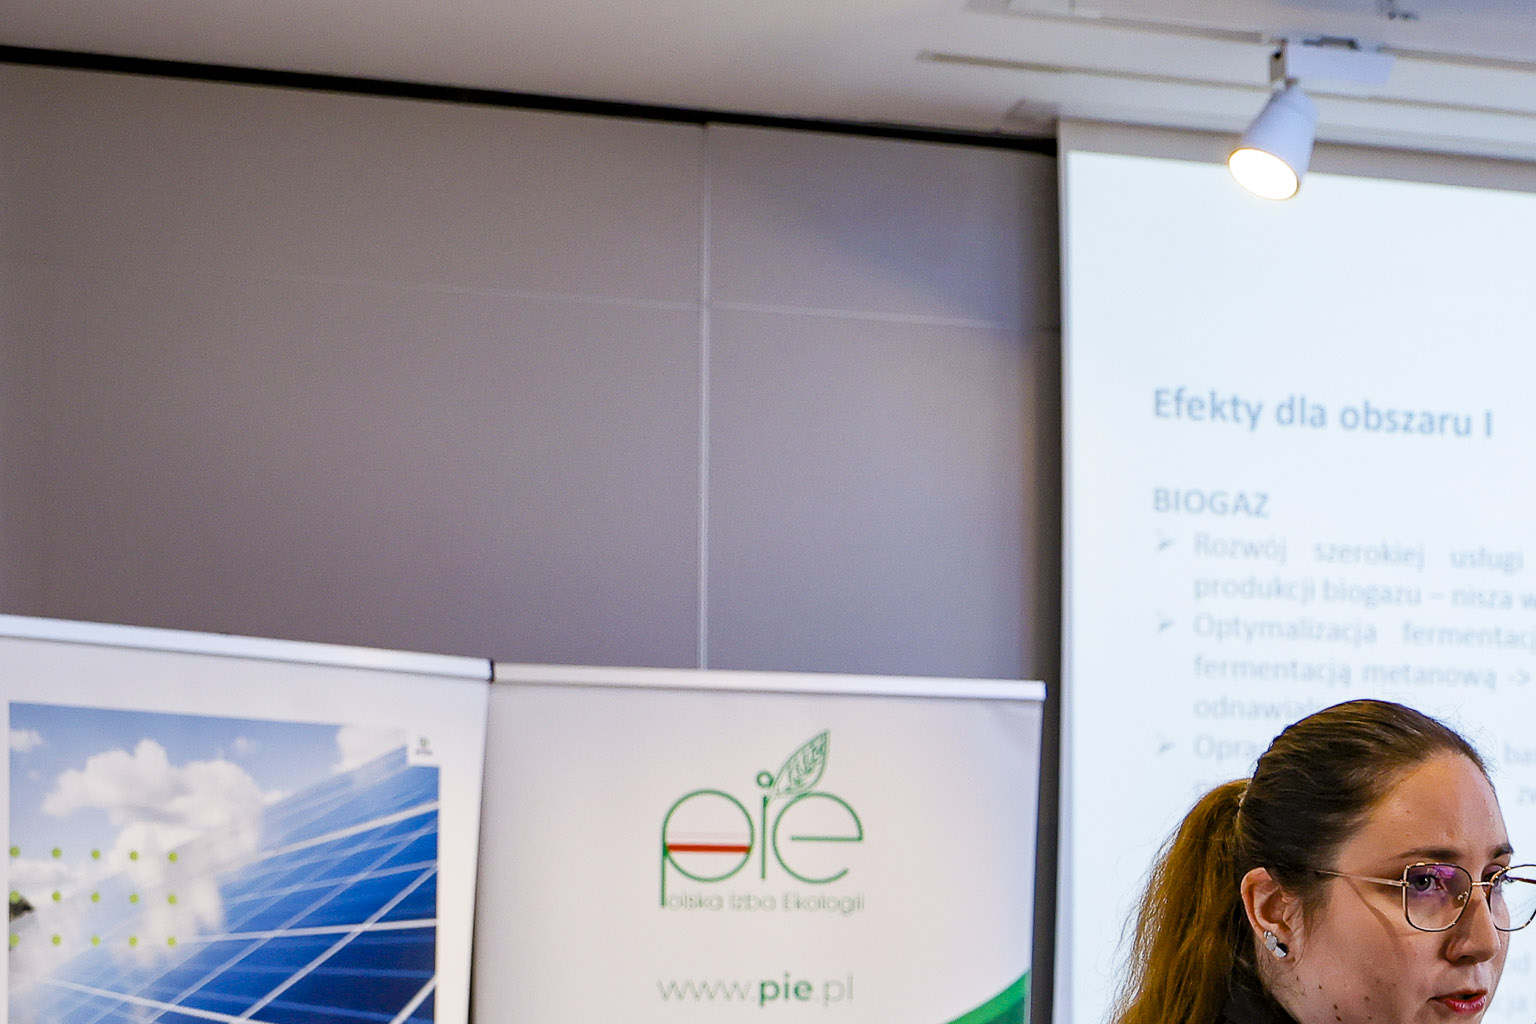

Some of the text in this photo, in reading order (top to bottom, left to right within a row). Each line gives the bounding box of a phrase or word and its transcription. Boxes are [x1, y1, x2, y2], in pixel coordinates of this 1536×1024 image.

[1153, 386, 1263, 432] Efekty
[1275, 395, 1327, 429] dla
[1340, 400, 1472, 438] obszaru
[1153, 486, 1270, 519] BIOGAZ
[1194, 531, 1288, 565] Rozwój
[1315, 540, 1426, 571] szerokiej
[1450, 545, 1524, 576] usługi
[1194, 575, 1317, 606] produkcji
[1323, 579, 1422, 609] biogazu
[1452, 584, 1513, 610] nisza
[1193, 614, 1377, 648] Optymalizacja
[657, 972, 854, 1009] www.pie.pl
